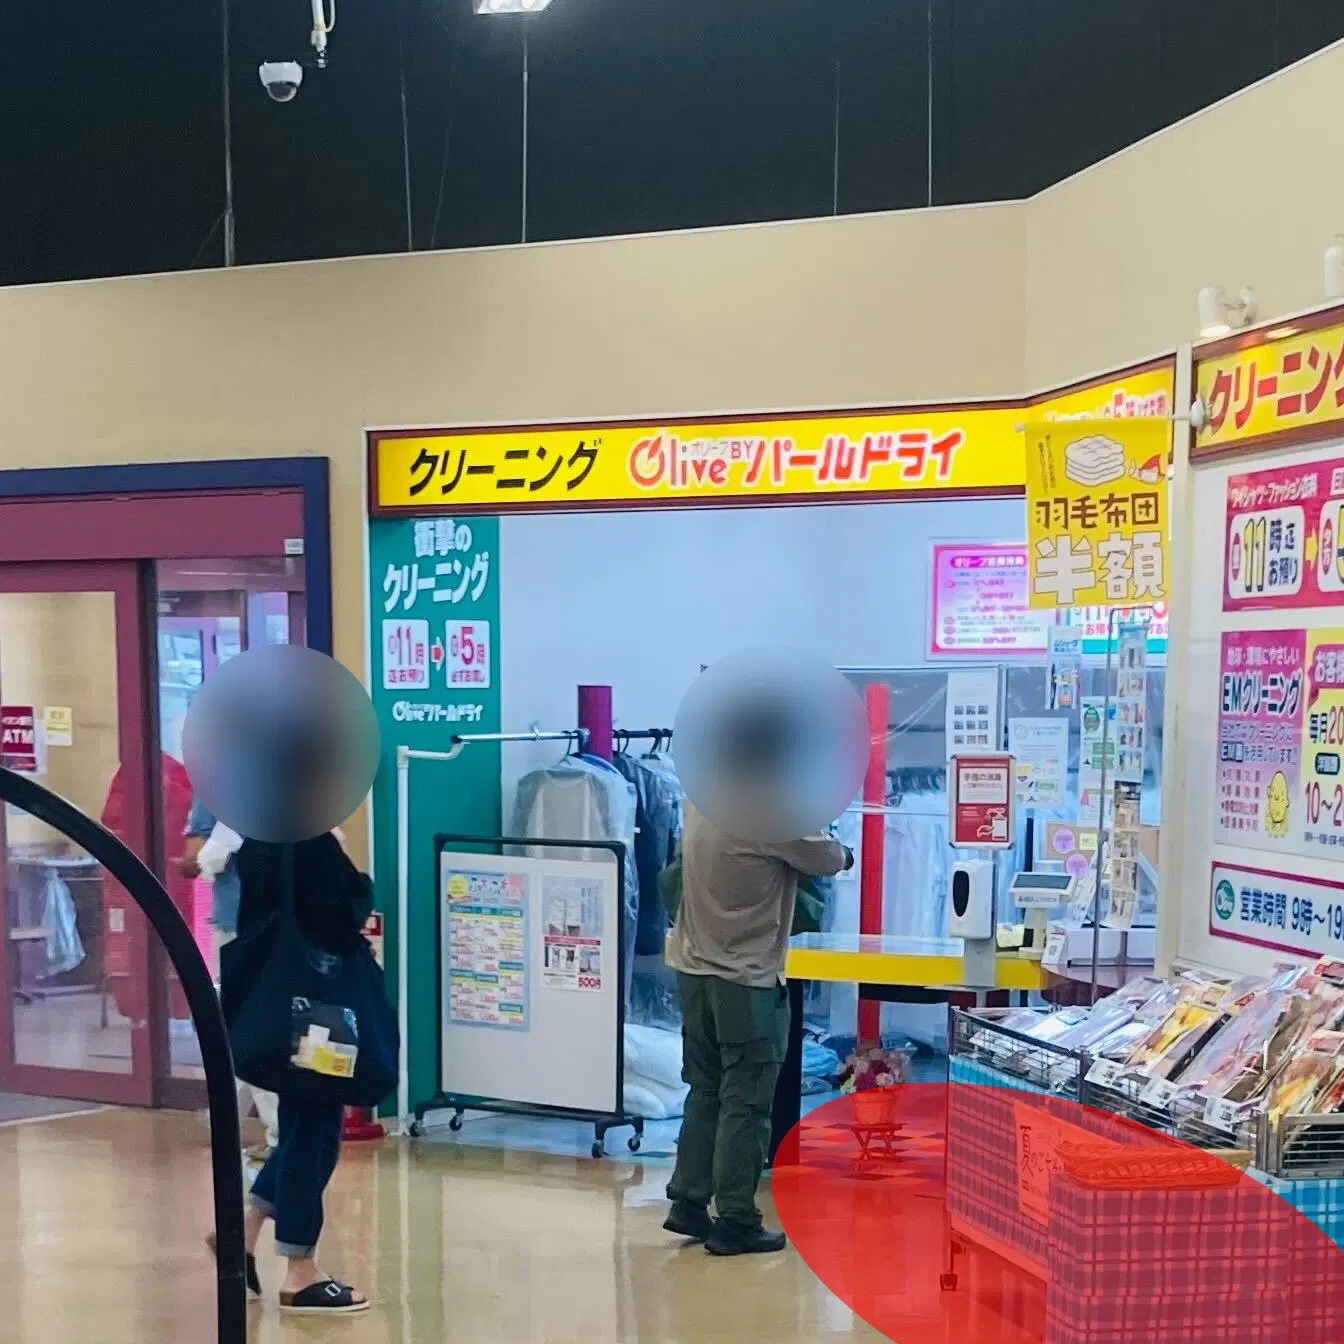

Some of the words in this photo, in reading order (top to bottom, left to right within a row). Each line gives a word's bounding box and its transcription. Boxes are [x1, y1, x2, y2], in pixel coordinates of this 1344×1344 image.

[409, 438, 603, 496] クリーニング
[630, 435, 728, 487] Olive
[745, 431, 962, 484] パールドライ
[1035, 492, 1159, 530] 羽毛布団
[383, 551, 489, 613] クリーニング
[1034, 531, 1167, 605] 半額
[1222, 669, 1303, 718] EMクリーニング
[2, 729, 34, 744] ATM
[1240, 886, 1287, 930] 営業時間
